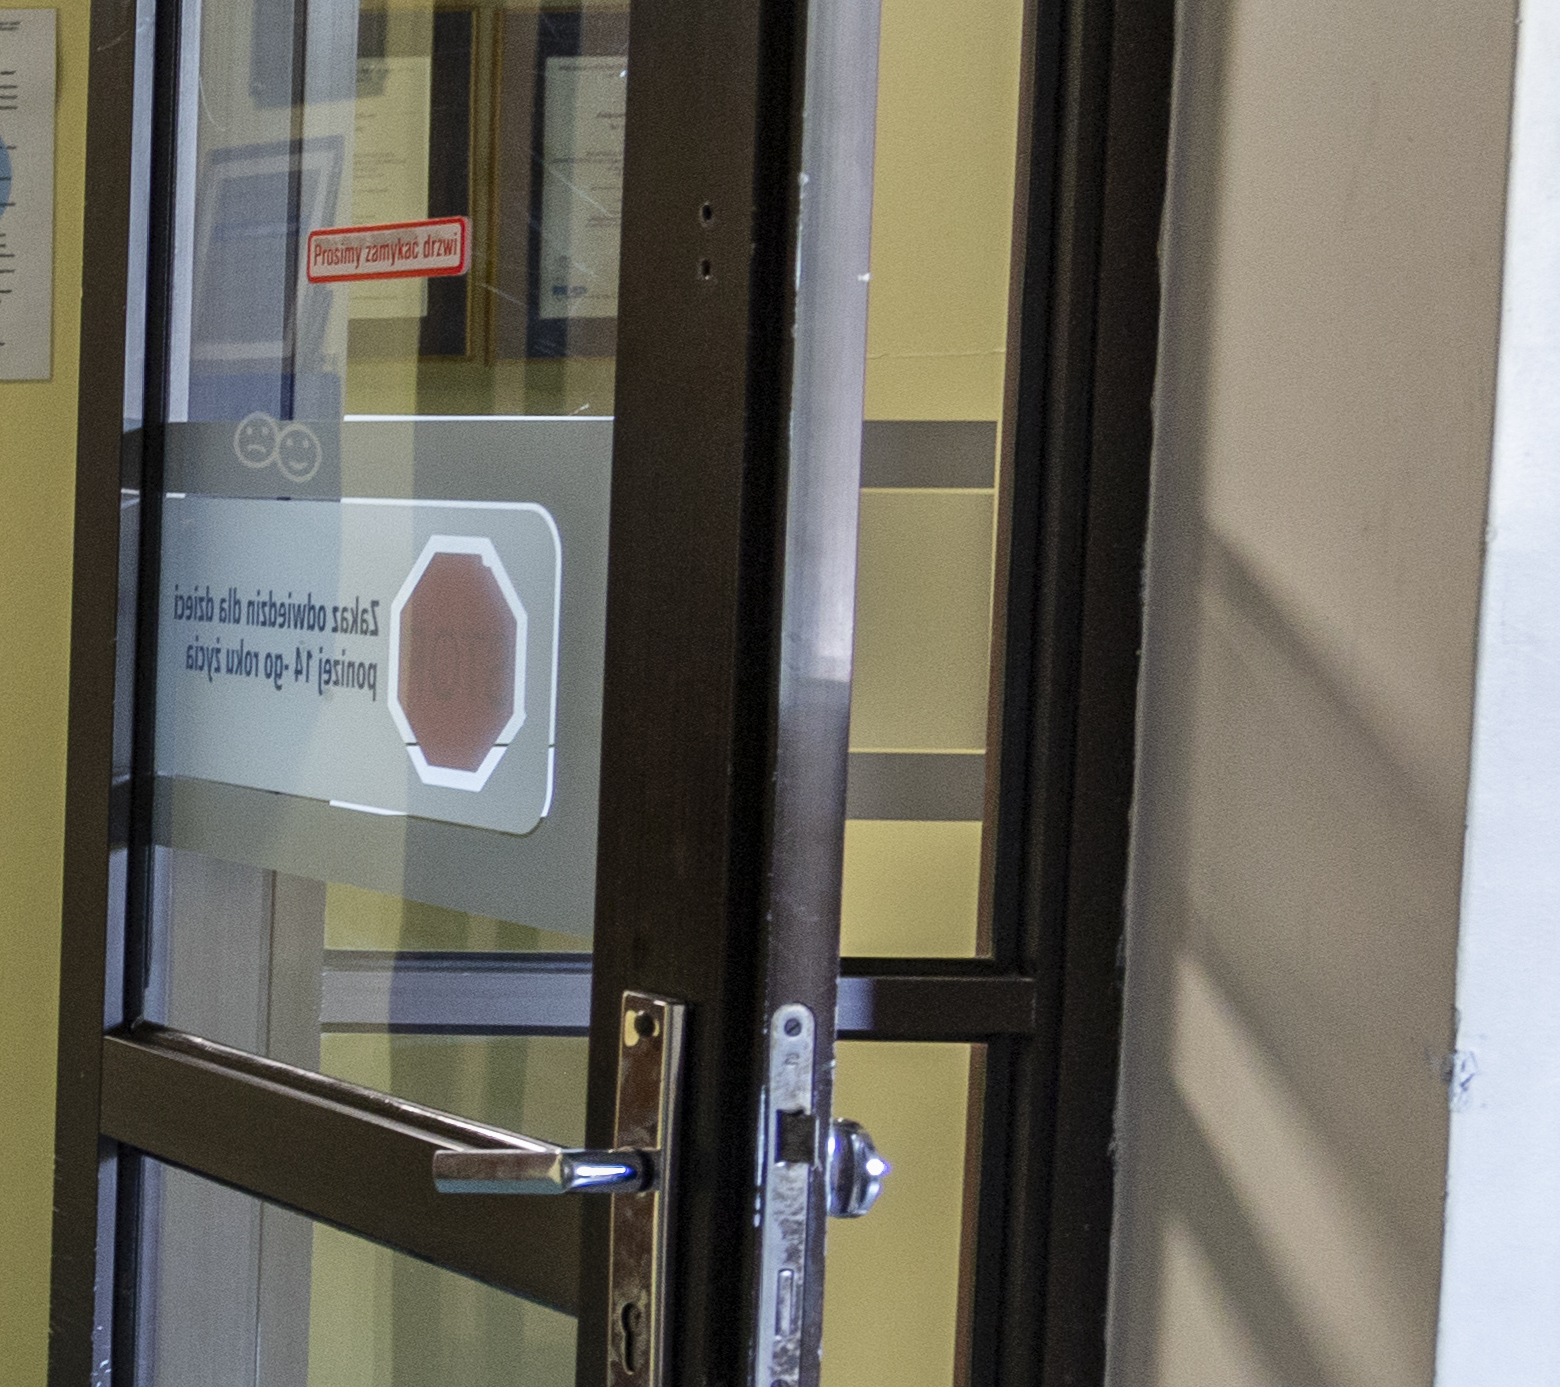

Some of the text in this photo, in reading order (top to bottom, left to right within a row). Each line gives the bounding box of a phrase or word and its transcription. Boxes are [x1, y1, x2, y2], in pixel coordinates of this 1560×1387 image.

[313, 232, 458, 270] Prosimy zamykać drzwi
